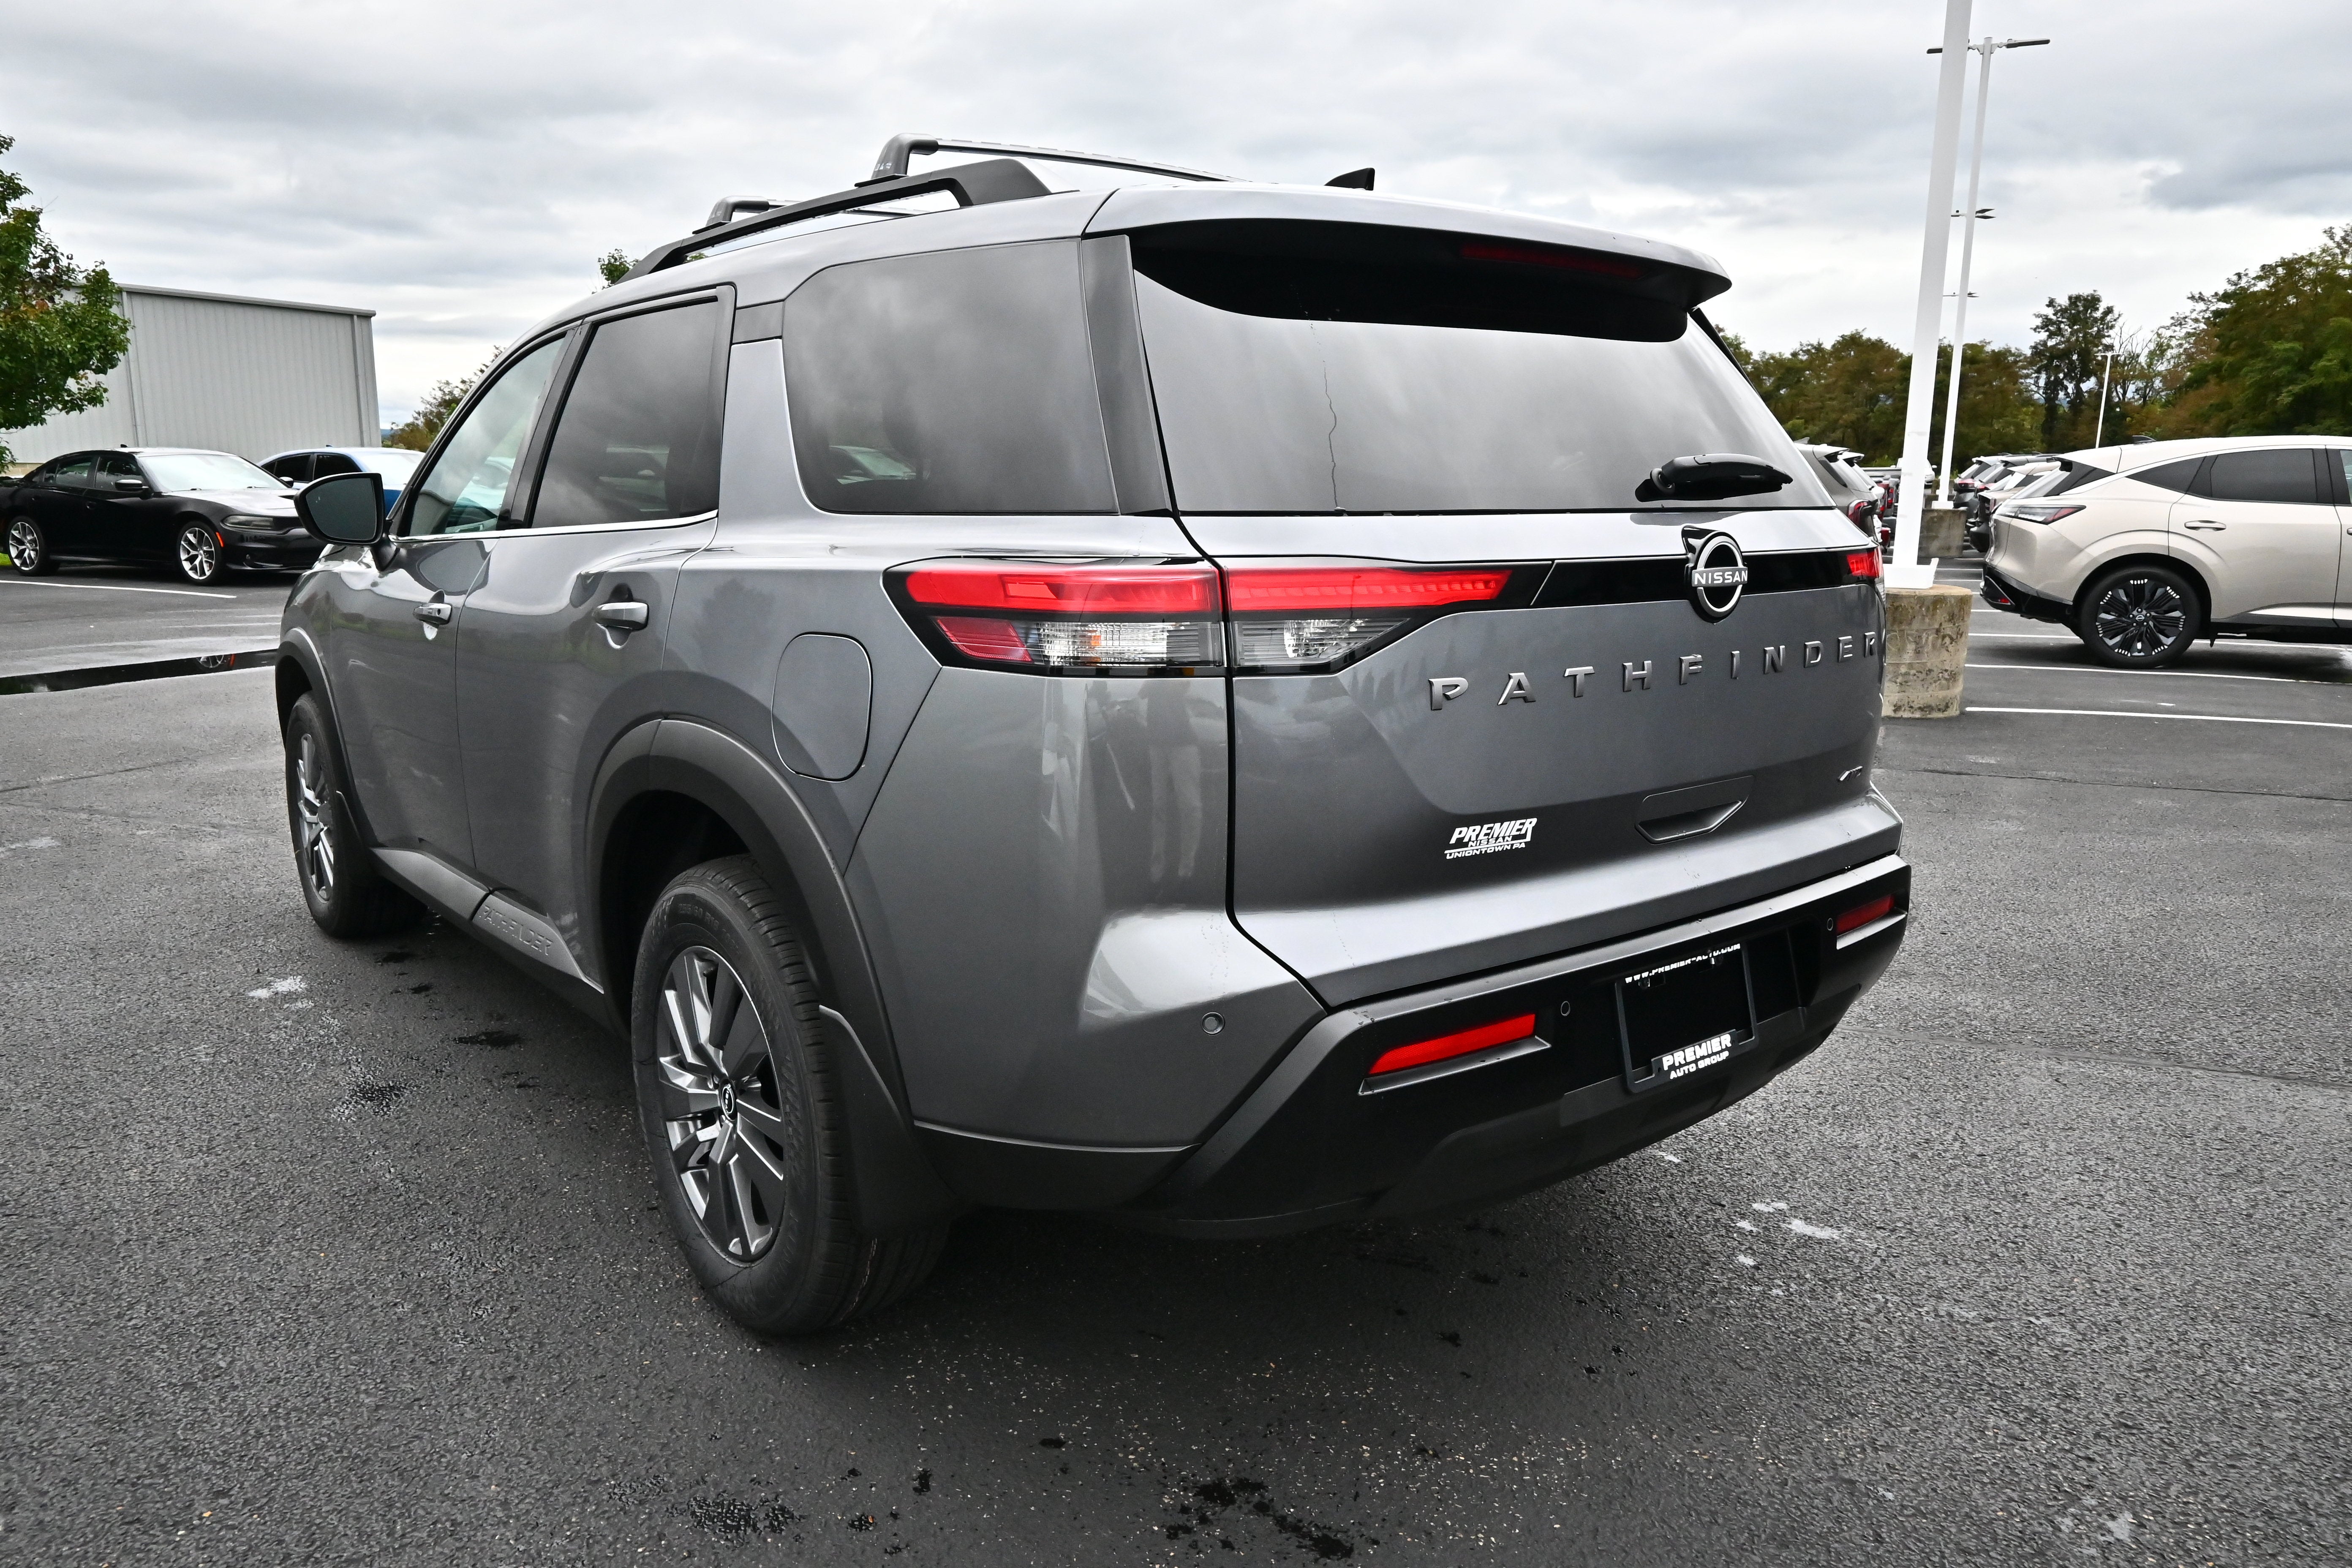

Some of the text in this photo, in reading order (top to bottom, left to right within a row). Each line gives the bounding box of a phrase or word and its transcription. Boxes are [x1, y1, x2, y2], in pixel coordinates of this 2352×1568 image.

[1694, 570, 1748, 585] NISSAN
[1429, 632, 1876, 710] PATHFINDER
[1449, 818, 1537, 844] PREMIER
[1468, 836, 1512, 847] NISSAN
[1446, 844, 1511, 859] UNIONTOWN
[1662, 1034, 1731, 1070] PREMIER
[1670, 1051, 1729, 1079] AUTO GROUP
